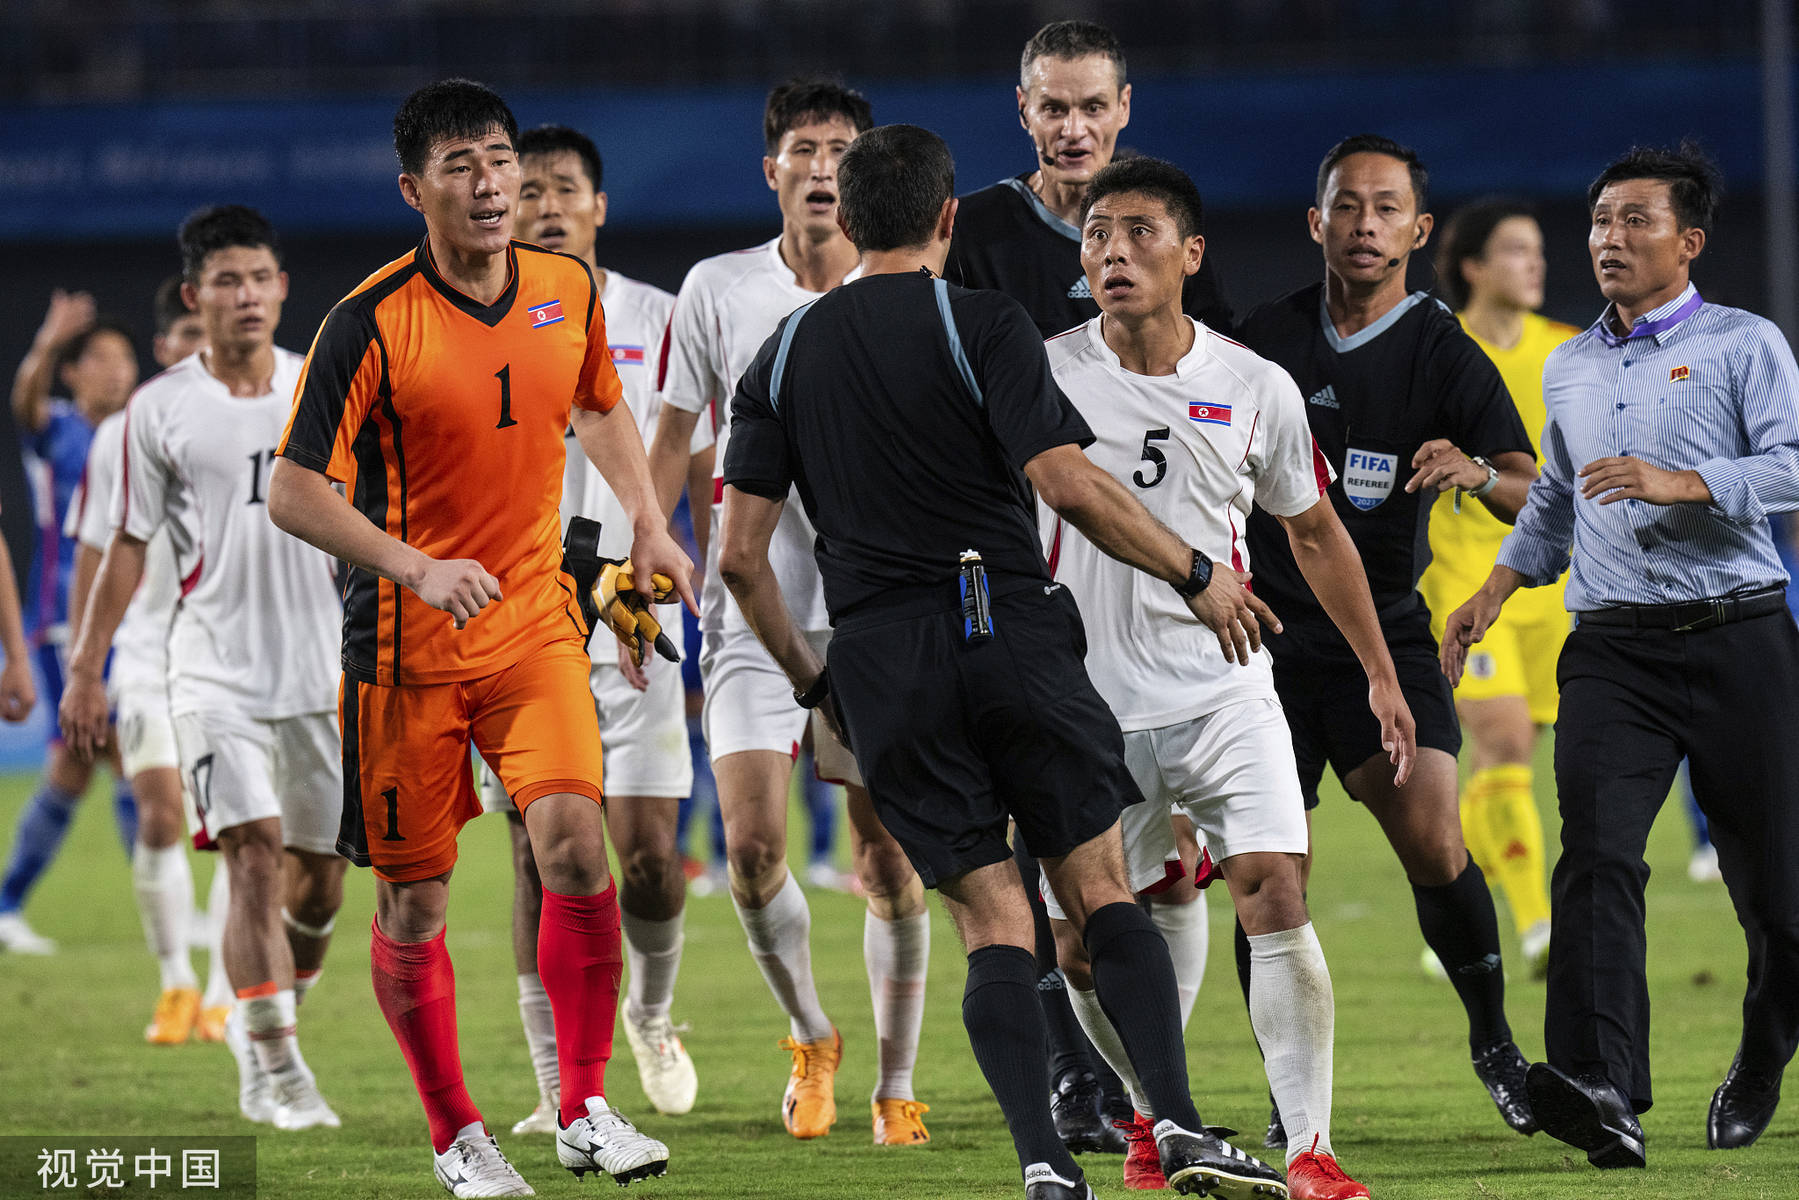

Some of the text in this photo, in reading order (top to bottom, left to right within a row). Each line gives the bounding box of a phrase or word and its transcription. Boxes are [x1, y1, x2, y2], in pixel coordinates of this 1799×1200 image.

[494, 362, 518, 430] 1
[1132, 425, 1171, 489] 5
[1347, 477, 1390, 490] REFEREE
[1349, 453, 1391, 473] FIFA
[380, 785, 407, 842] 1
